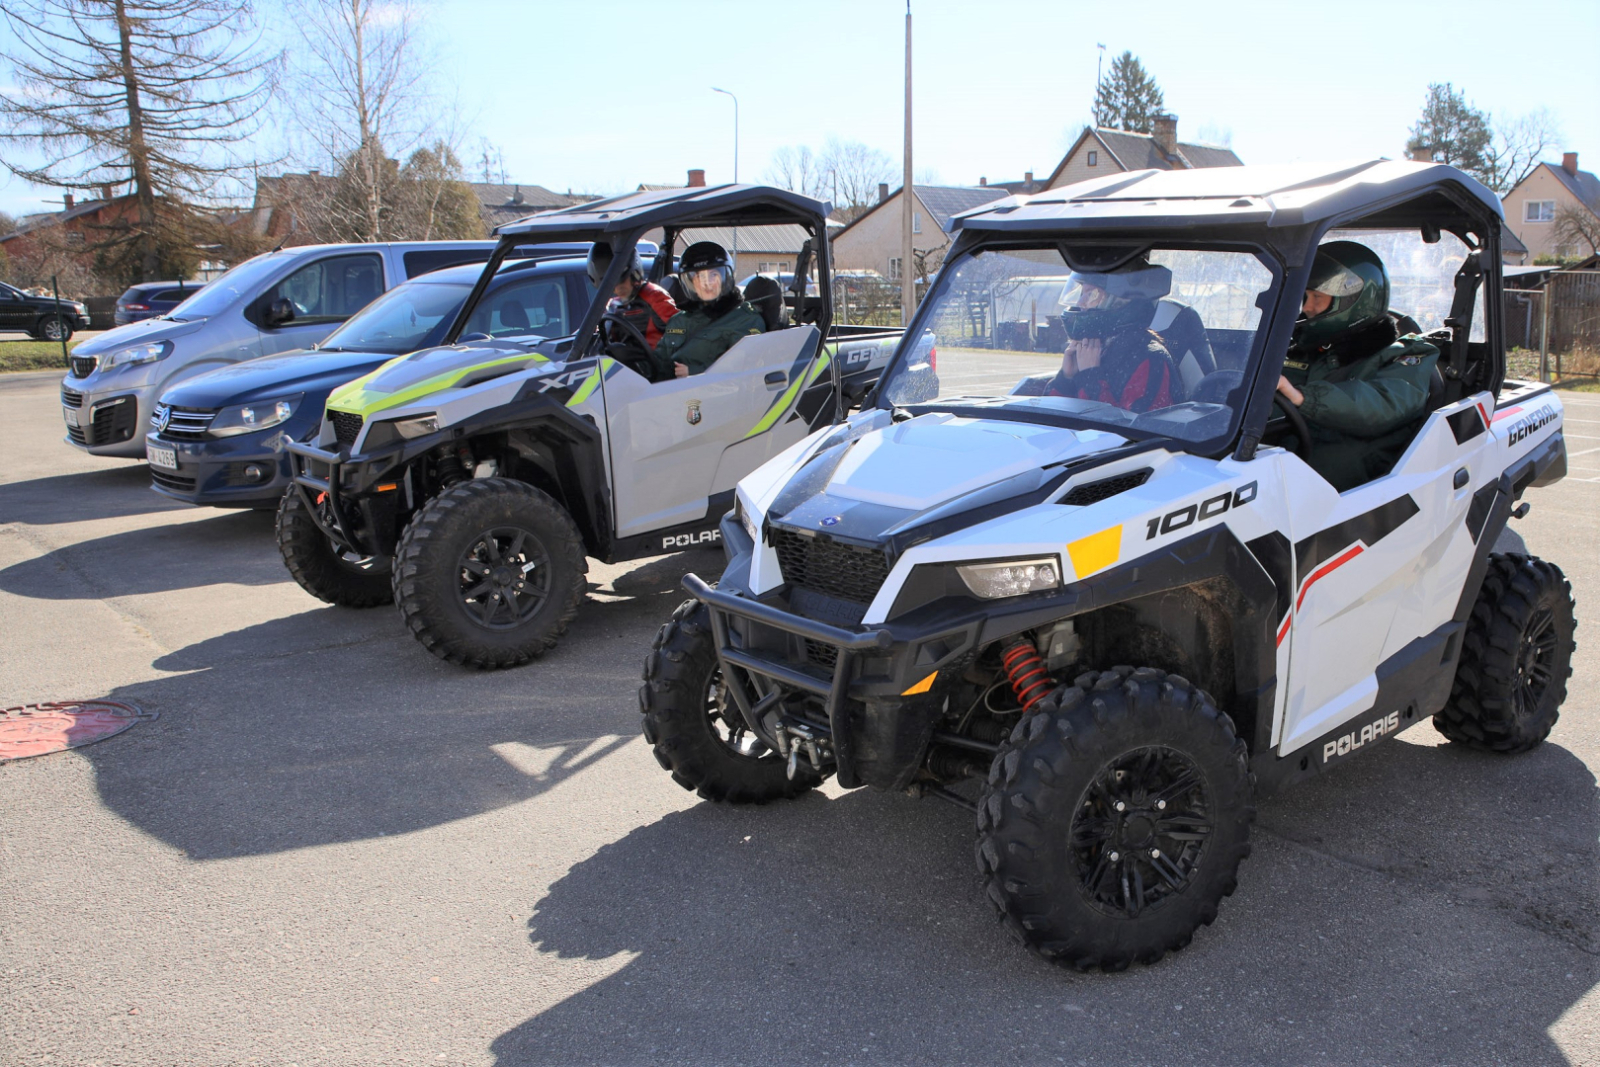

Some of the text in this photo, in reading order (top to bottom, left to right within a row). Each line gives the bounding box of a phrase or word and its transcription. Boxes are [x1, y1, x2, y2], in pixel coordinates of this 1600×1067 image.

[538, 365, 597, 393] XP
[1506, 403, 1558, 448] GENERAL
[1145, 479, 1258, 541] 1000
[1323, 710, 1399, 763] POLARIS
